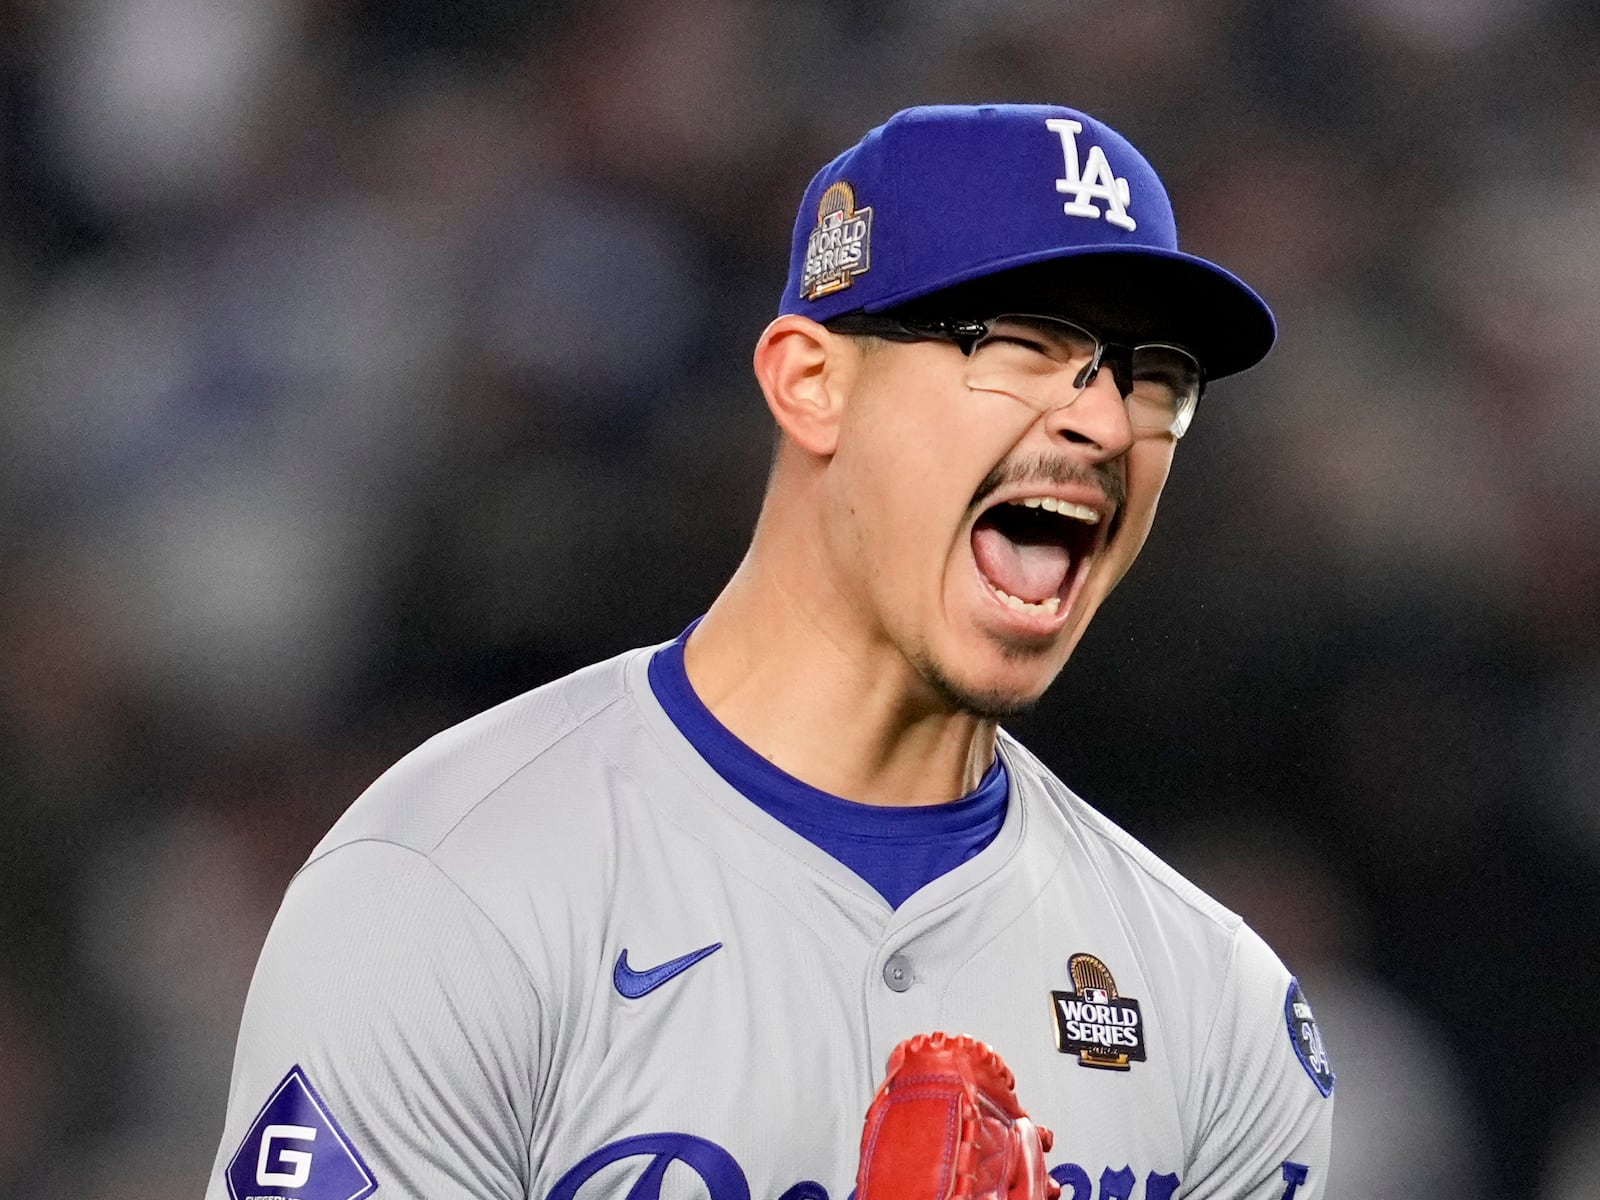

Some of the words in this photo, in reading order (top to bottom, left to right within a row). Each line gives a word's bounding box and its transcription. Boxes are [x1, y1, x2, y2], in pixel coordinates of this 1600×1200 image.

[1045, 118, 1137, 232] LA
[808, 220, 867, 259] WORLD
[804, 241, 862, 280] SERIES
[1058, 1000, 1138, 1027] WORLD
[1066, 1021, 1139, 1047] SERIES
[256, 1124, 317, 1189] G
